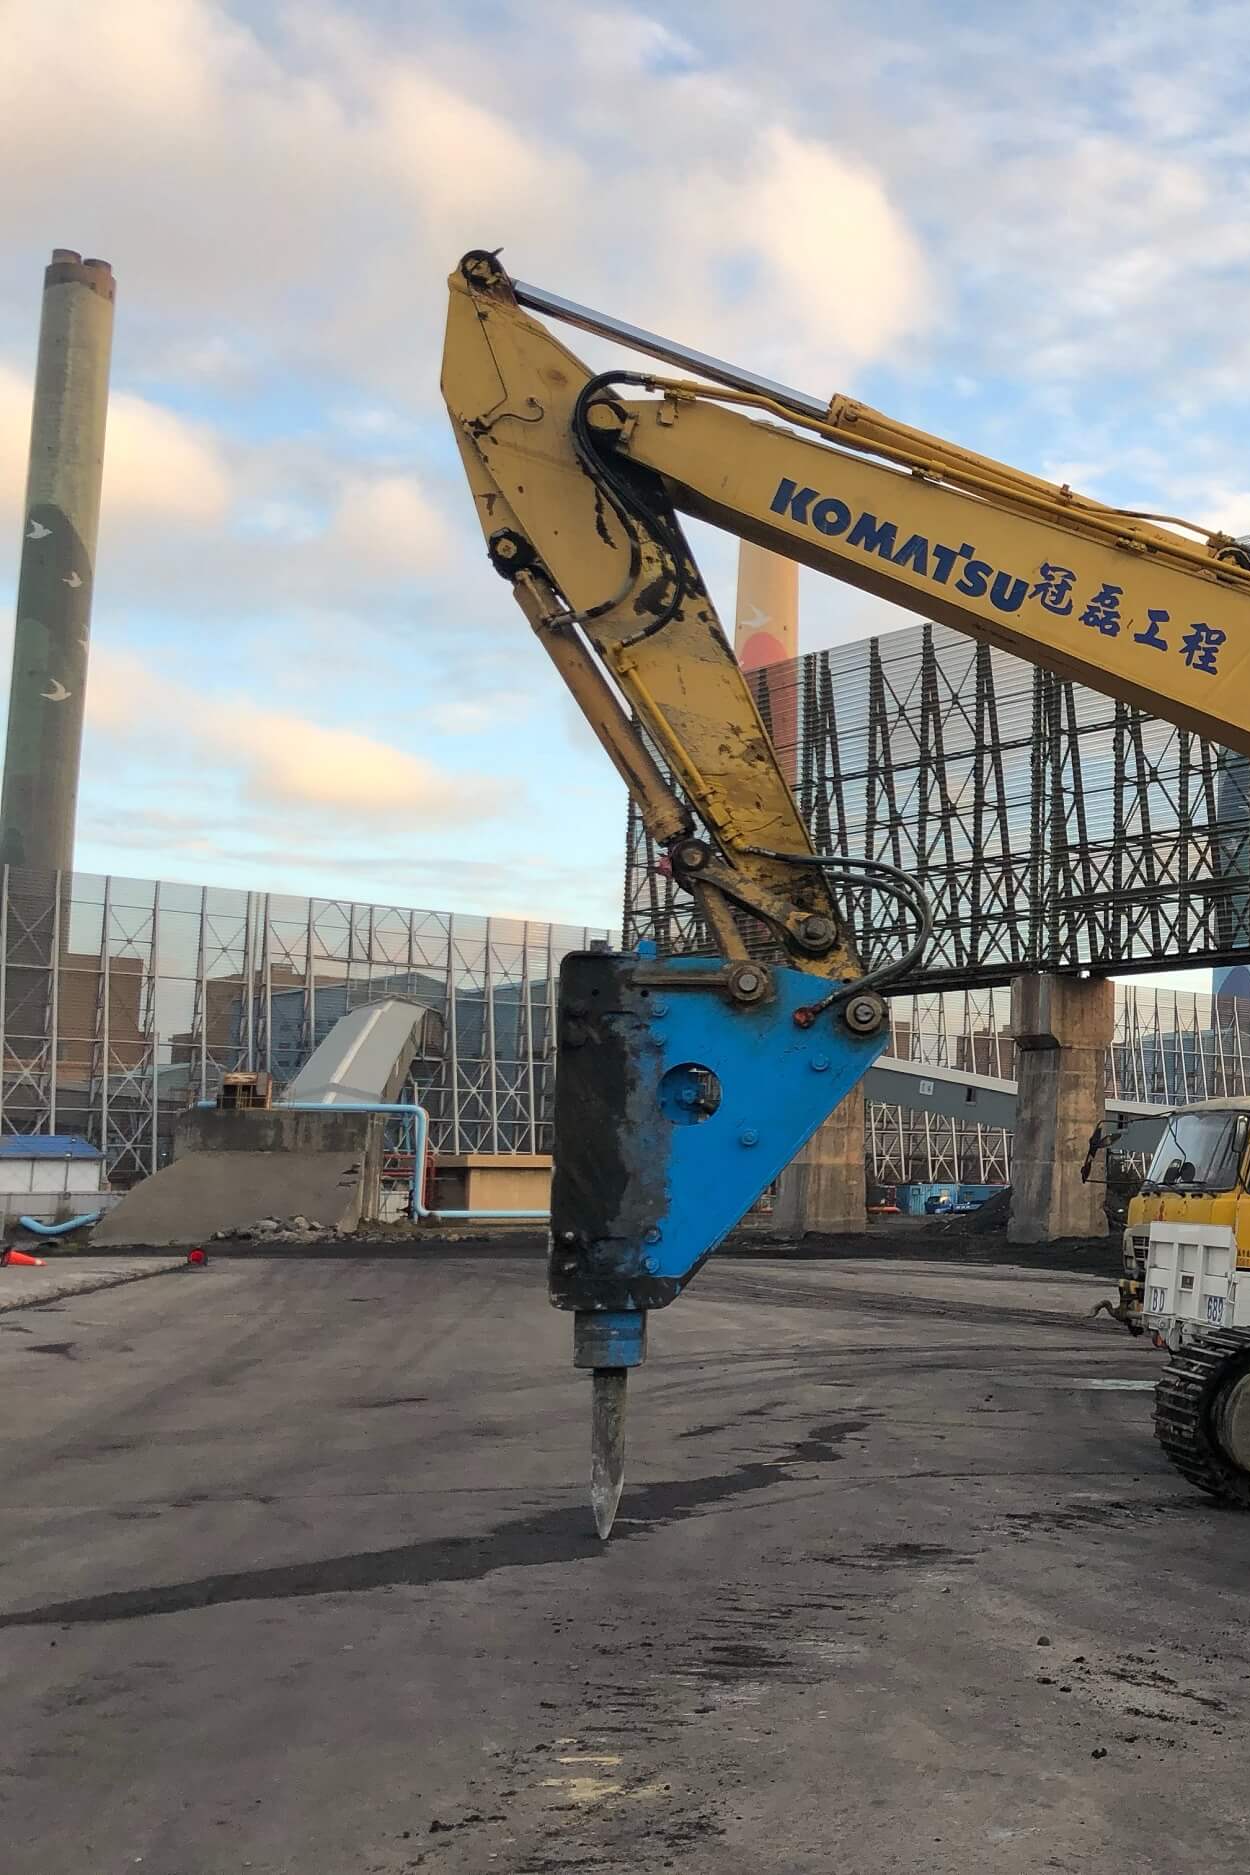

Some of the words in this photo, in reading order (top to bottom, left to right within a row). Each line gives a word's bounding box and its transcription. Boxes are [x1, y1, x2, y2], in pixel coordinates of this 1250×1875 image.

[770, 478, 1030, 613] KOMATSU
[1029, 563, 1226, 676] 冠磊工程
